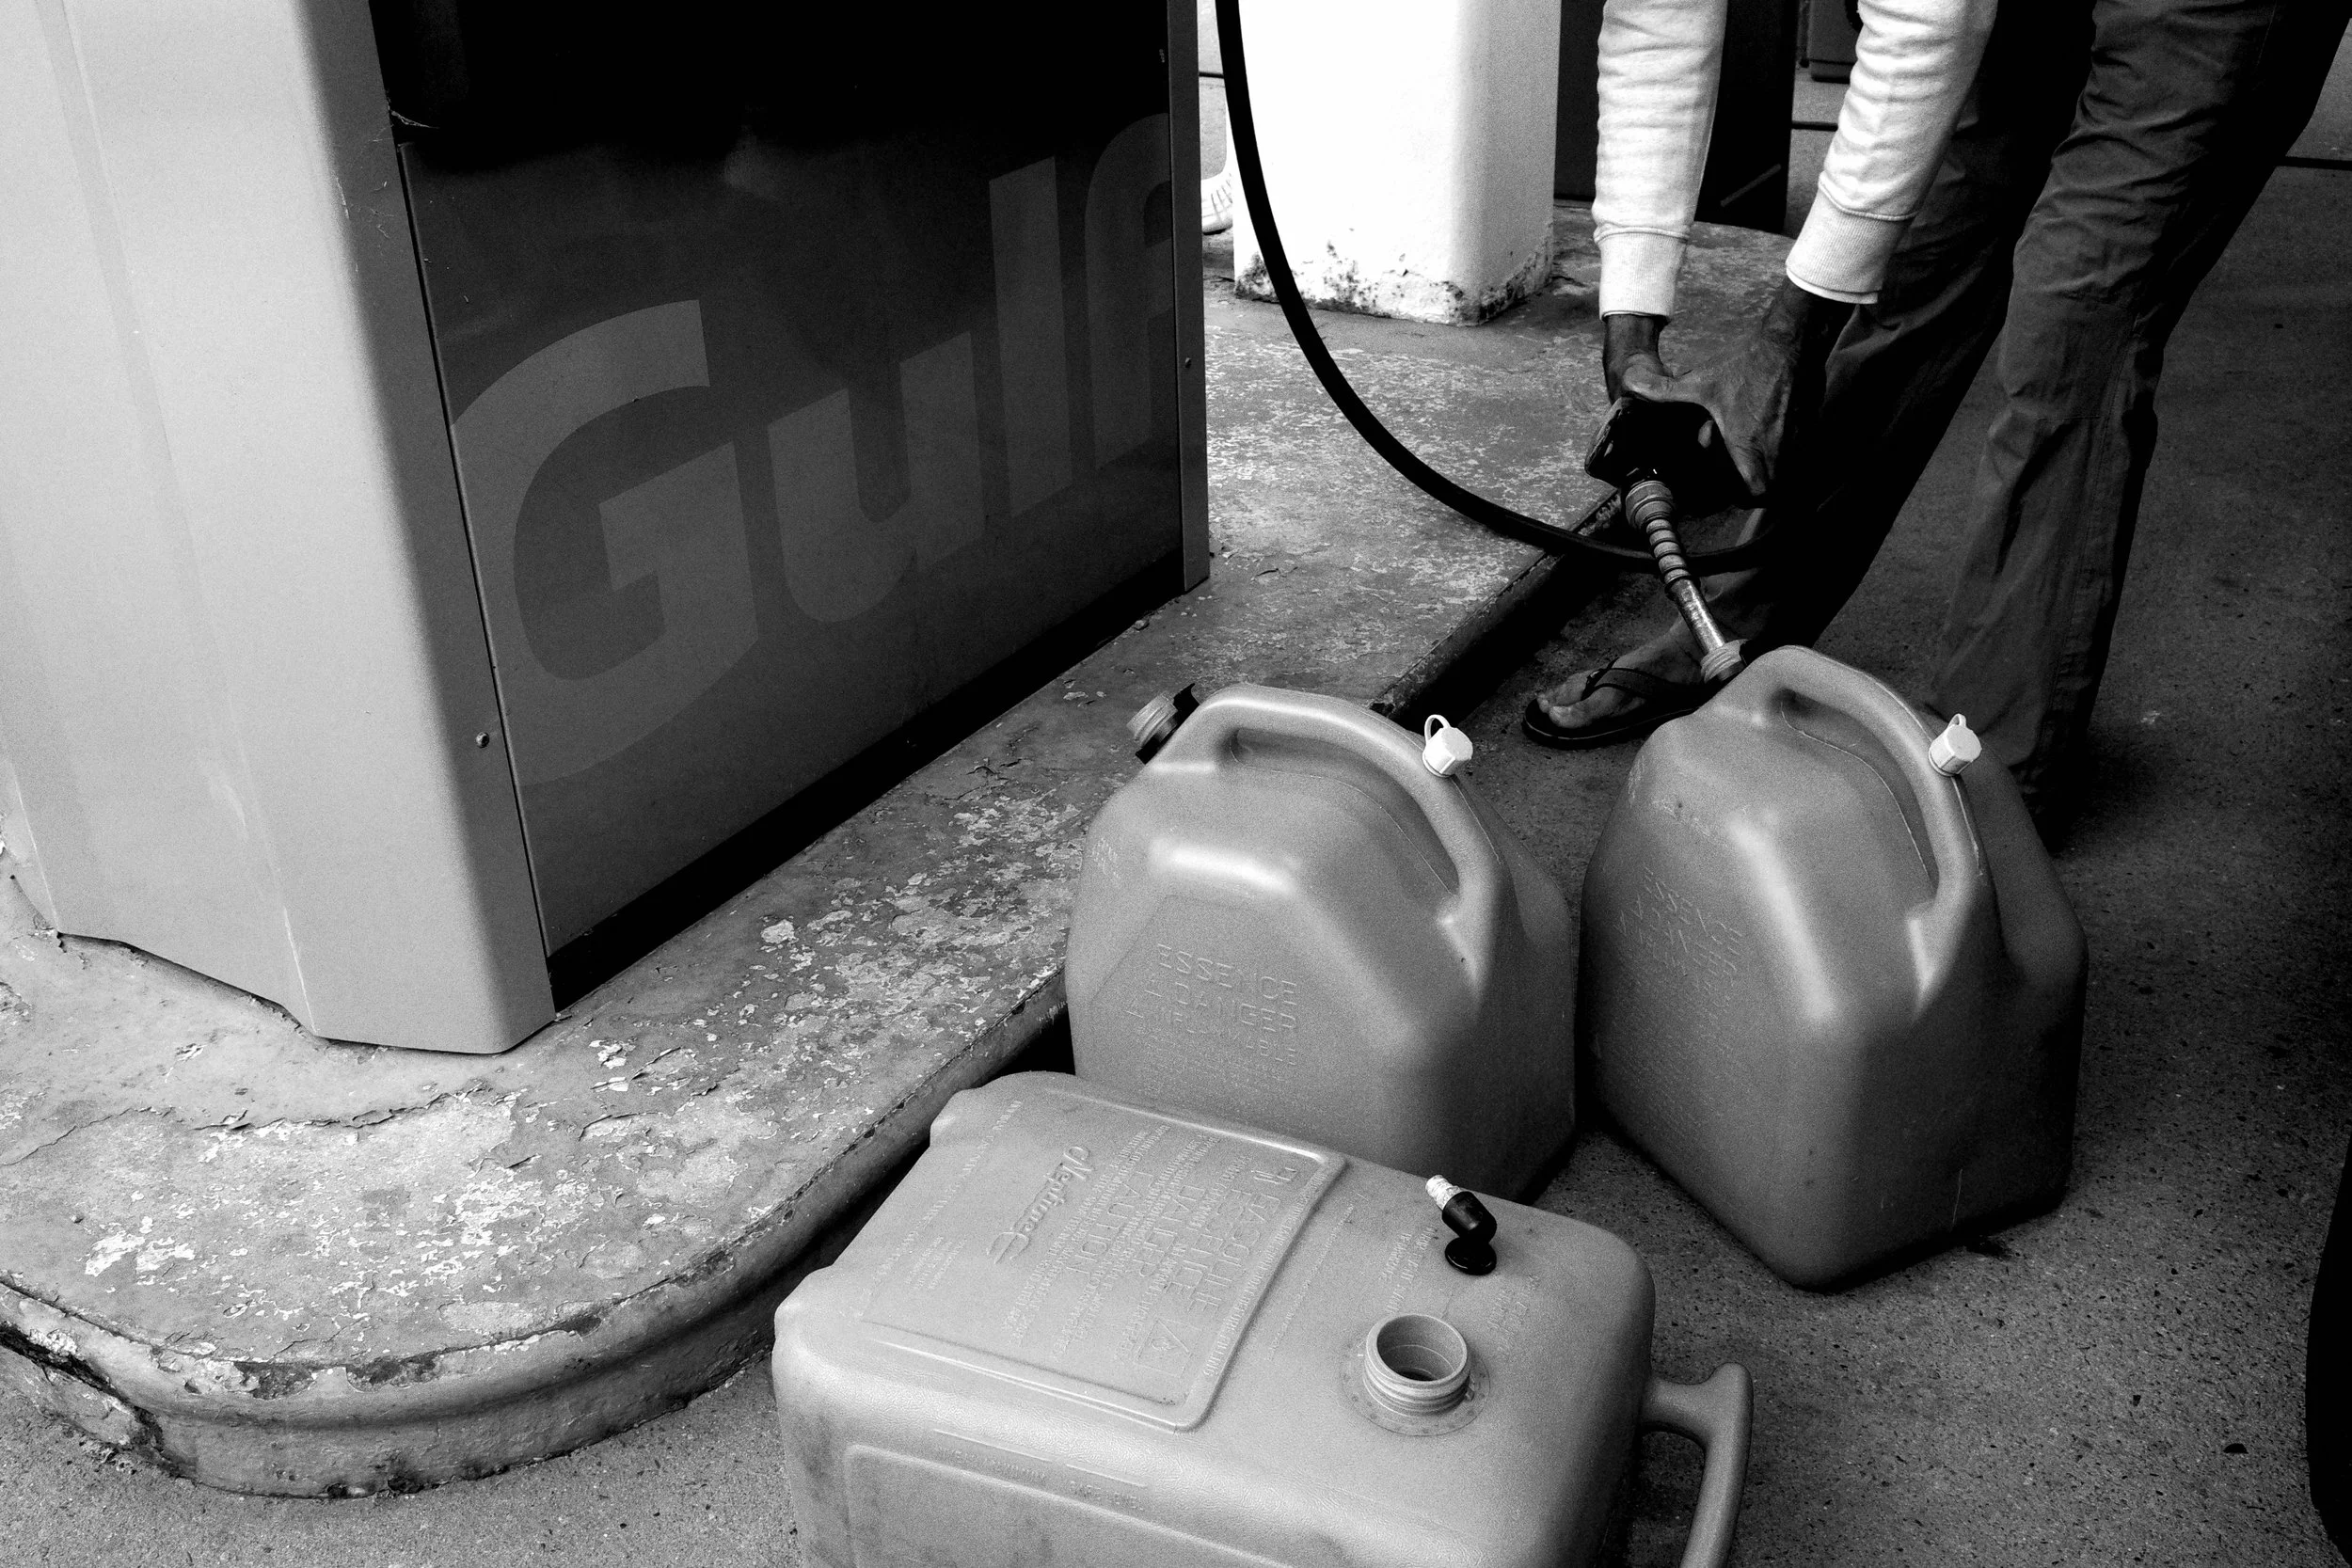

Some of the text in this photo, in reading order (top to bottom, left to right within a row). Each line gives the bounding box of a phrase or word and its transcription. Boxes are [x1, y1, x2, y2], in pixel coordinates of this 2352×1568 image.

[453, 112, 1175, 784] Gulf
[1157, 942, 1297, 1006] ESSENCE
[1001, 1144, 1105, 1241] Neptune
[1063, 1169, 1158, 1275] CAUTION
[1123, 1183, 1207, 1279] DANGER
[1162, 1186, 1253, 1300] ESSENCE
[1184, 1192, 1284, 1319] GASOLINE
[1198, 1334, 1235, 1377] FILLING
